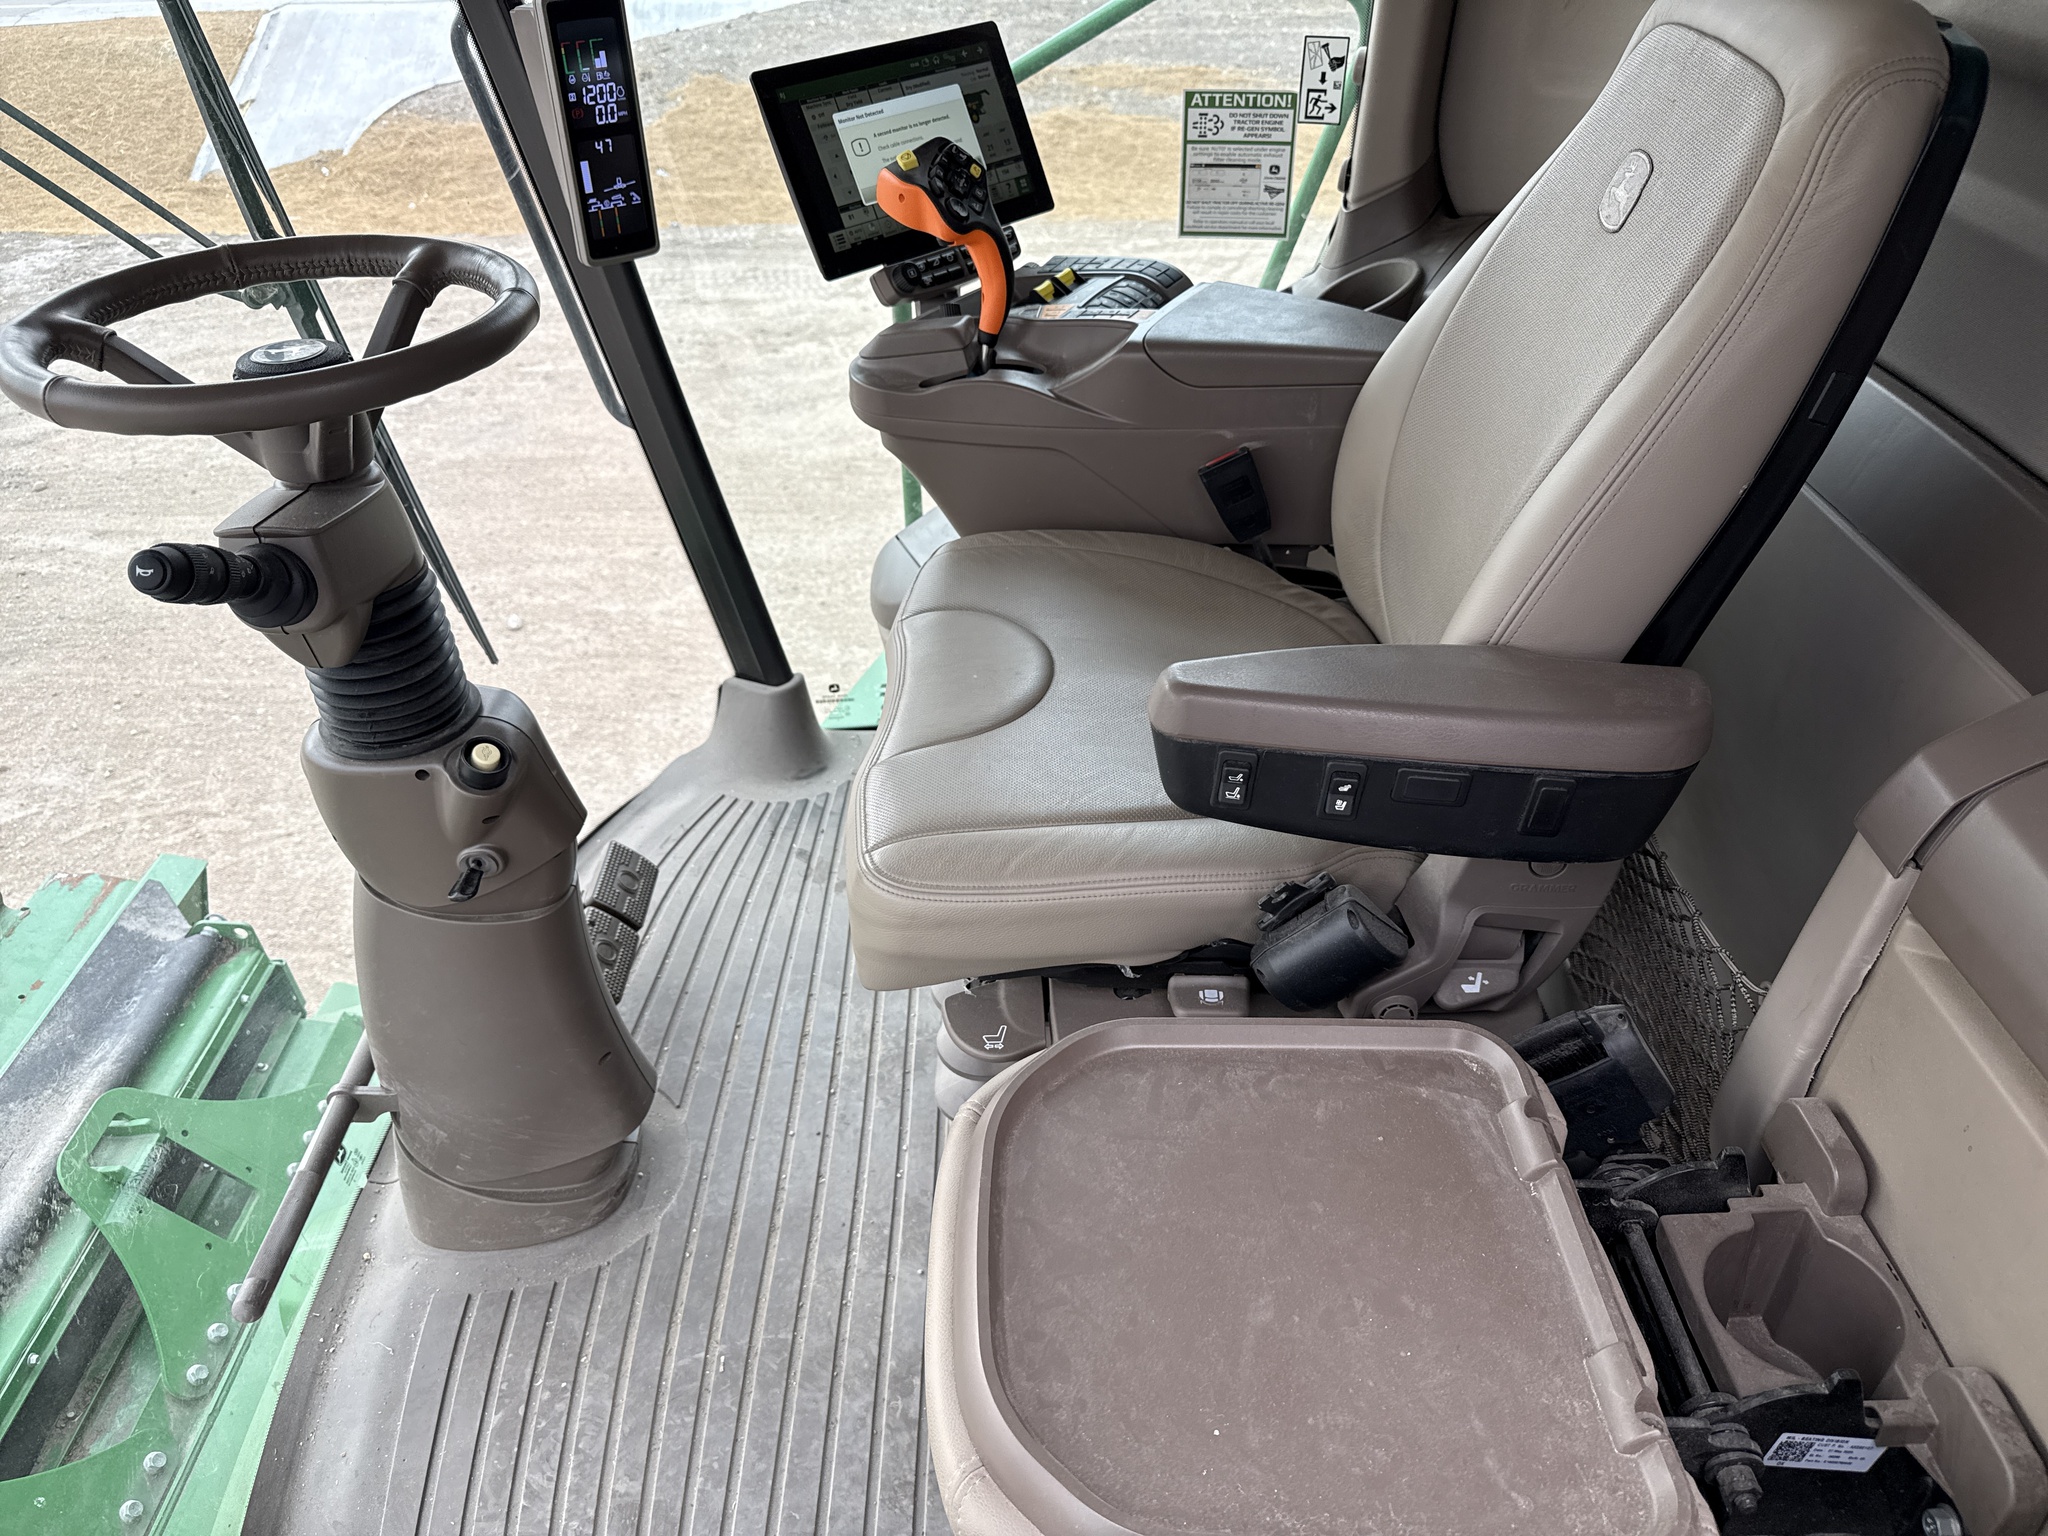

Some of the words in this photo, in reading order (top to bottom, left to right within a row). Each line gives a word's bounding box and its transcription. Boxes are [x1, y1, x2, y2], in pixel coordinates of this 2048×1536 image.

[582, 82, 617, 105] 1200
[1190, 93, 1292, 108] ATTENTION!
[595, 103, 618, 126] 0.0
[864, 108, 884, 118] Detected
[878, 129, 892, 137] second
[892, 125, 908, 133] monitor
[594, 138, 613, 154] 47
[1510, 882, 1577, 893] GRAMMER
